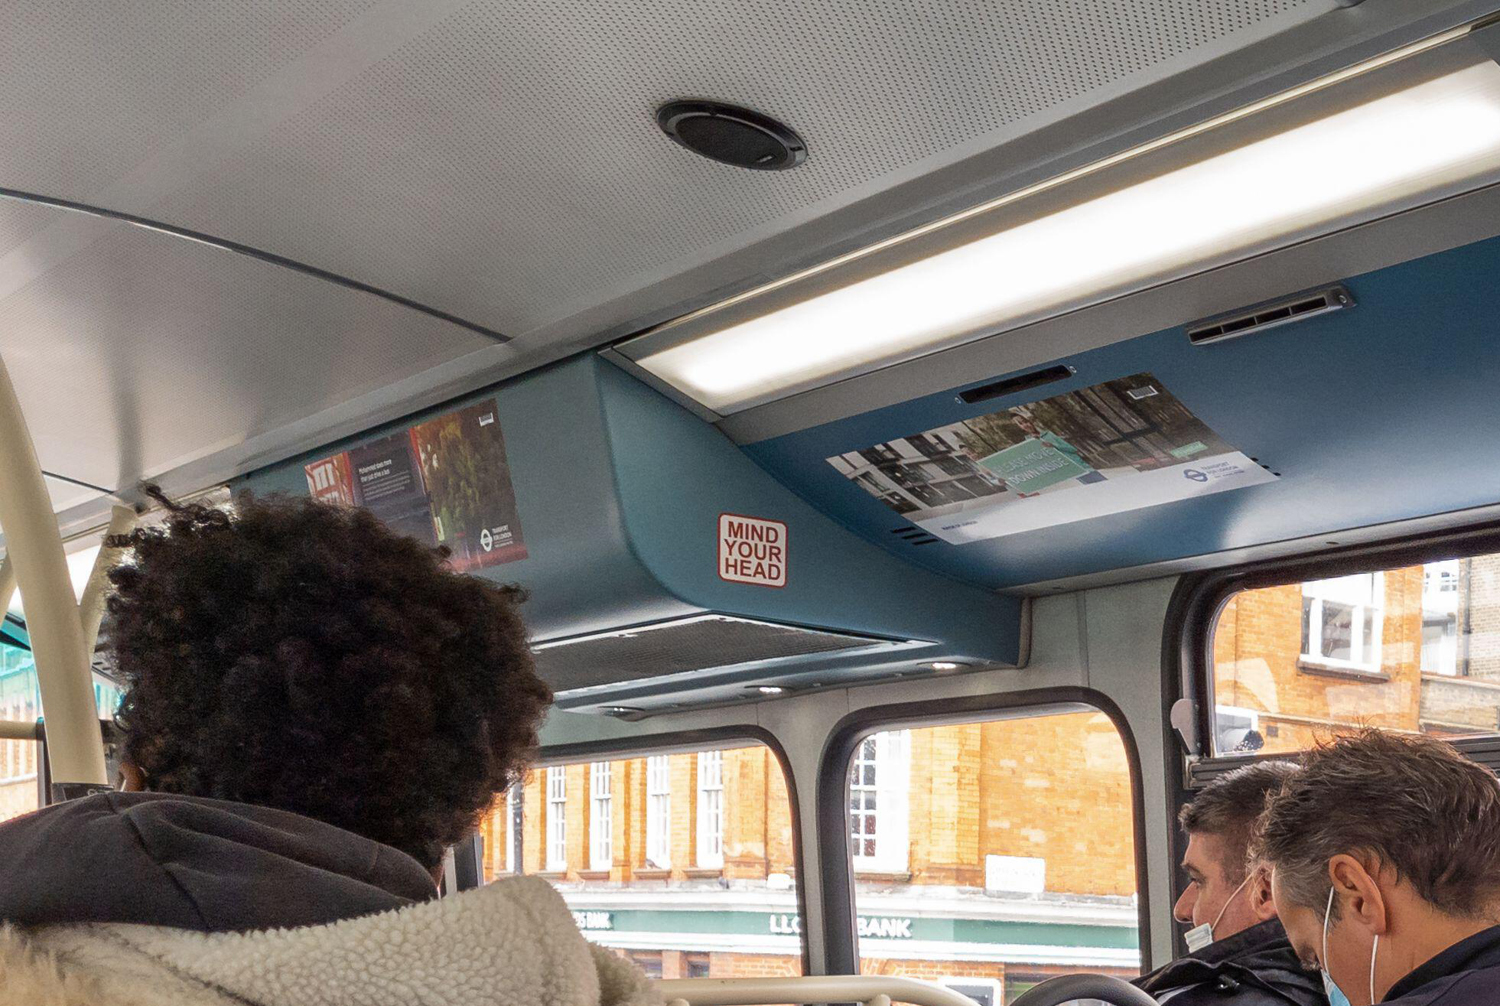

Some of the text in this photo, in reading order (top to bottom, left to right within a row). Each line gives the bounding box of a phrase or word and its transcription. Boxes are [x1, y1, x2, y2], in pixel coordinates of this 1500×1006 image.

[1008, 457, 1070, 485] DOWN INSIDE
[727, 521, 779, 543] MIND
[723, 538, 782, 564] YOUR
[725, 557, 781, 580] HEAD
[769, 914, 912, 938] LLO BANK
